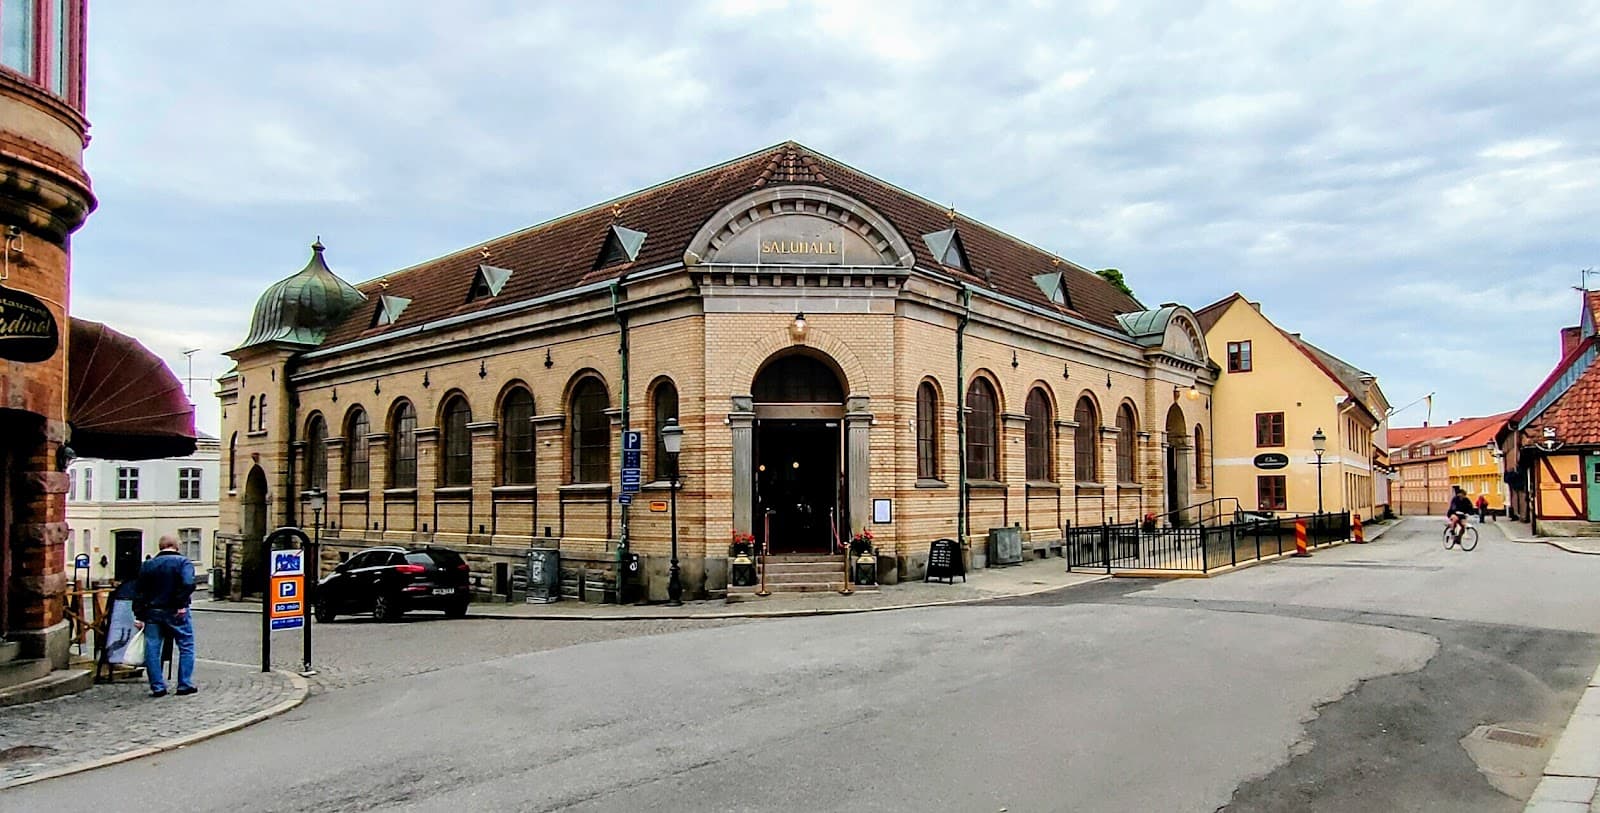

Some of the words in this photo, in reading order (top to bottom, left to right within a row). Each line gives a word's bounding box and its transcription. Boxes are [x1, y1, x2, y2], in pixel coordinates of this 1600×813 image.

[761, 240, 838, 255] SALUHALL
[628, 433, 638, 449] P
[282, 583, 294, 596] P
